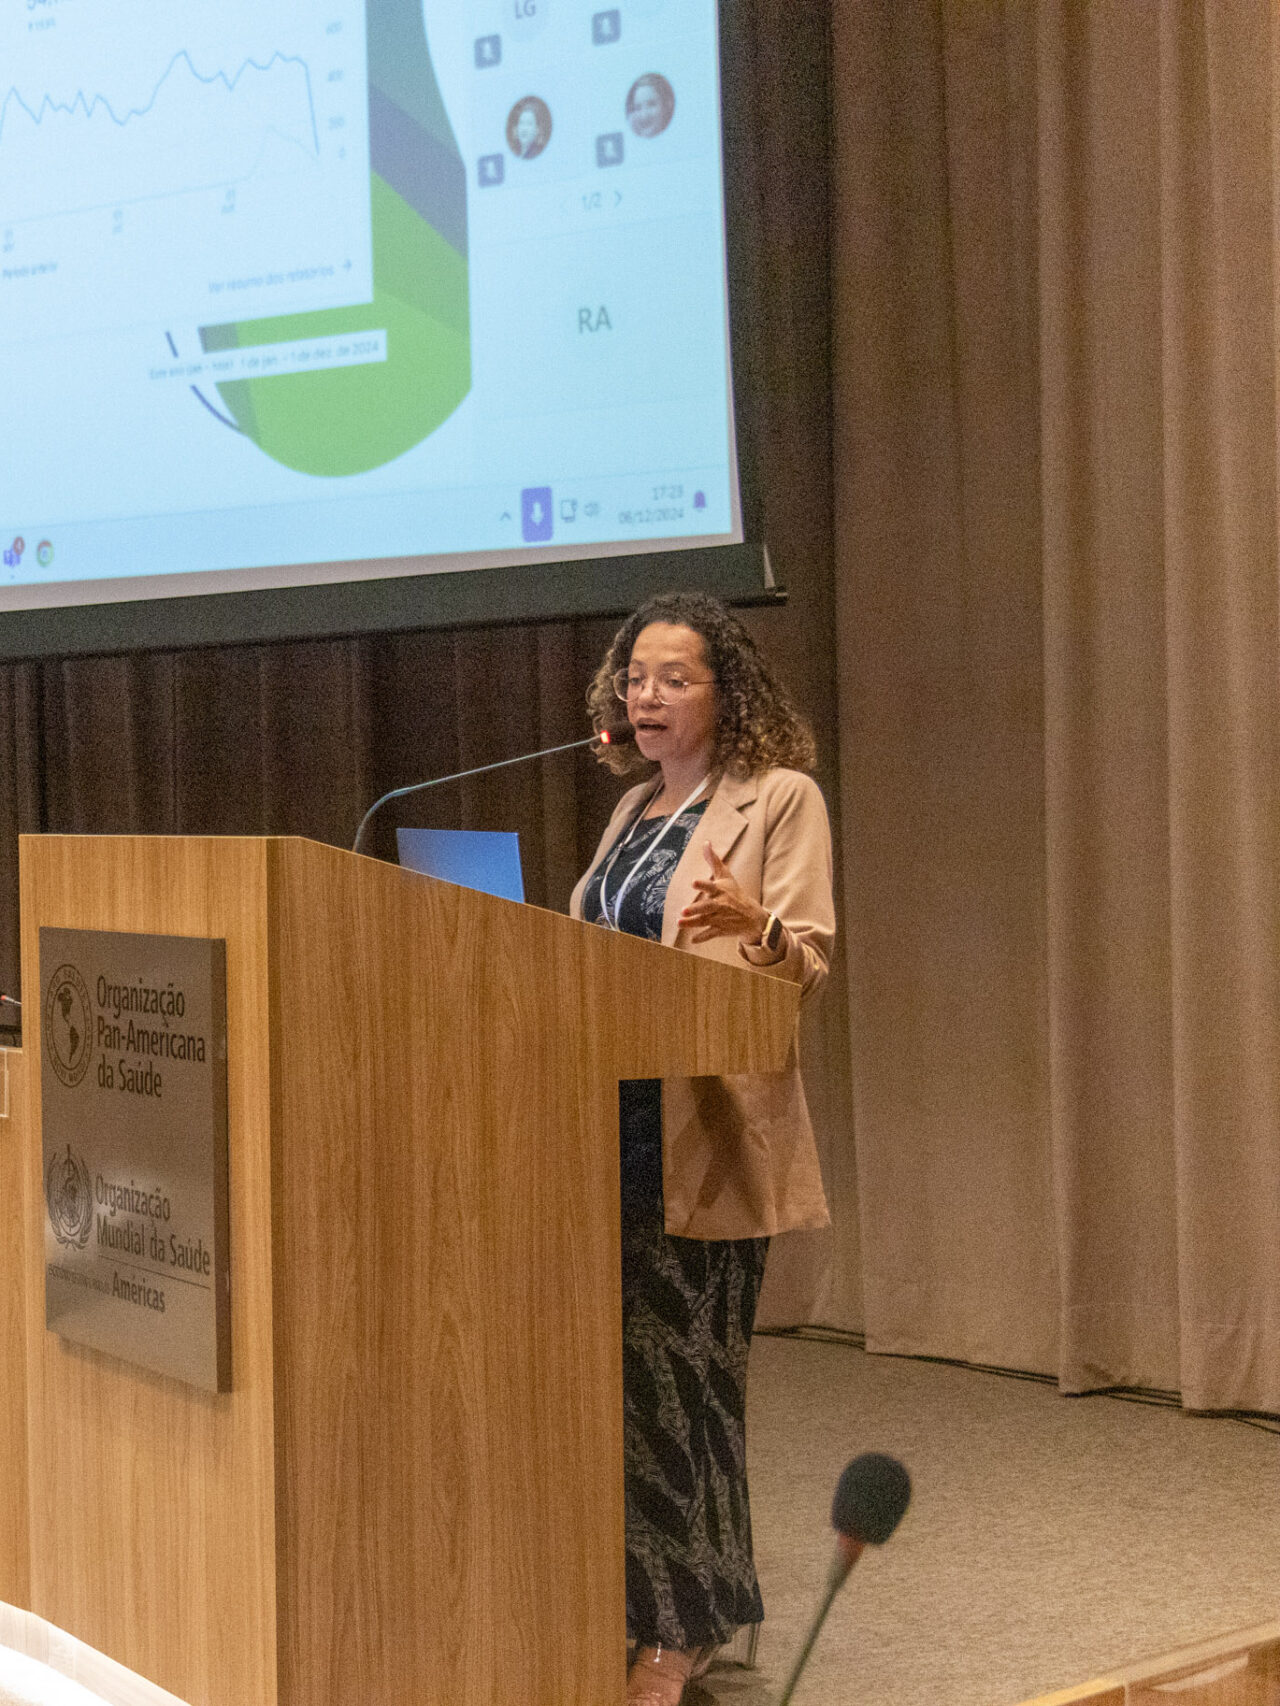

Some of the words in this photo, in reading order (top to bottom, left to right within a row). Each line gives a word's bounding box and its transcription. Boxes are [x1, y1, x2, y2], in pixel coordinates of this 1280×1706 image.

[577, 305, 613, 335] RA
[97, 974, 186, 1028] Organização
[97, 1015, 206, 1063] Pan-Americana
[97, 1053, 114, 1090] da
[119, 1058, 163, 1098] Saúde
[94, 1173, 171, 1228] Organização
[96, 1212, 146, 1259] Mundial
[150, 1228, 166, 1262] da
[169, 1233, 211, 1277] Saúde
[112, 1270, 166, 1313] Américas
